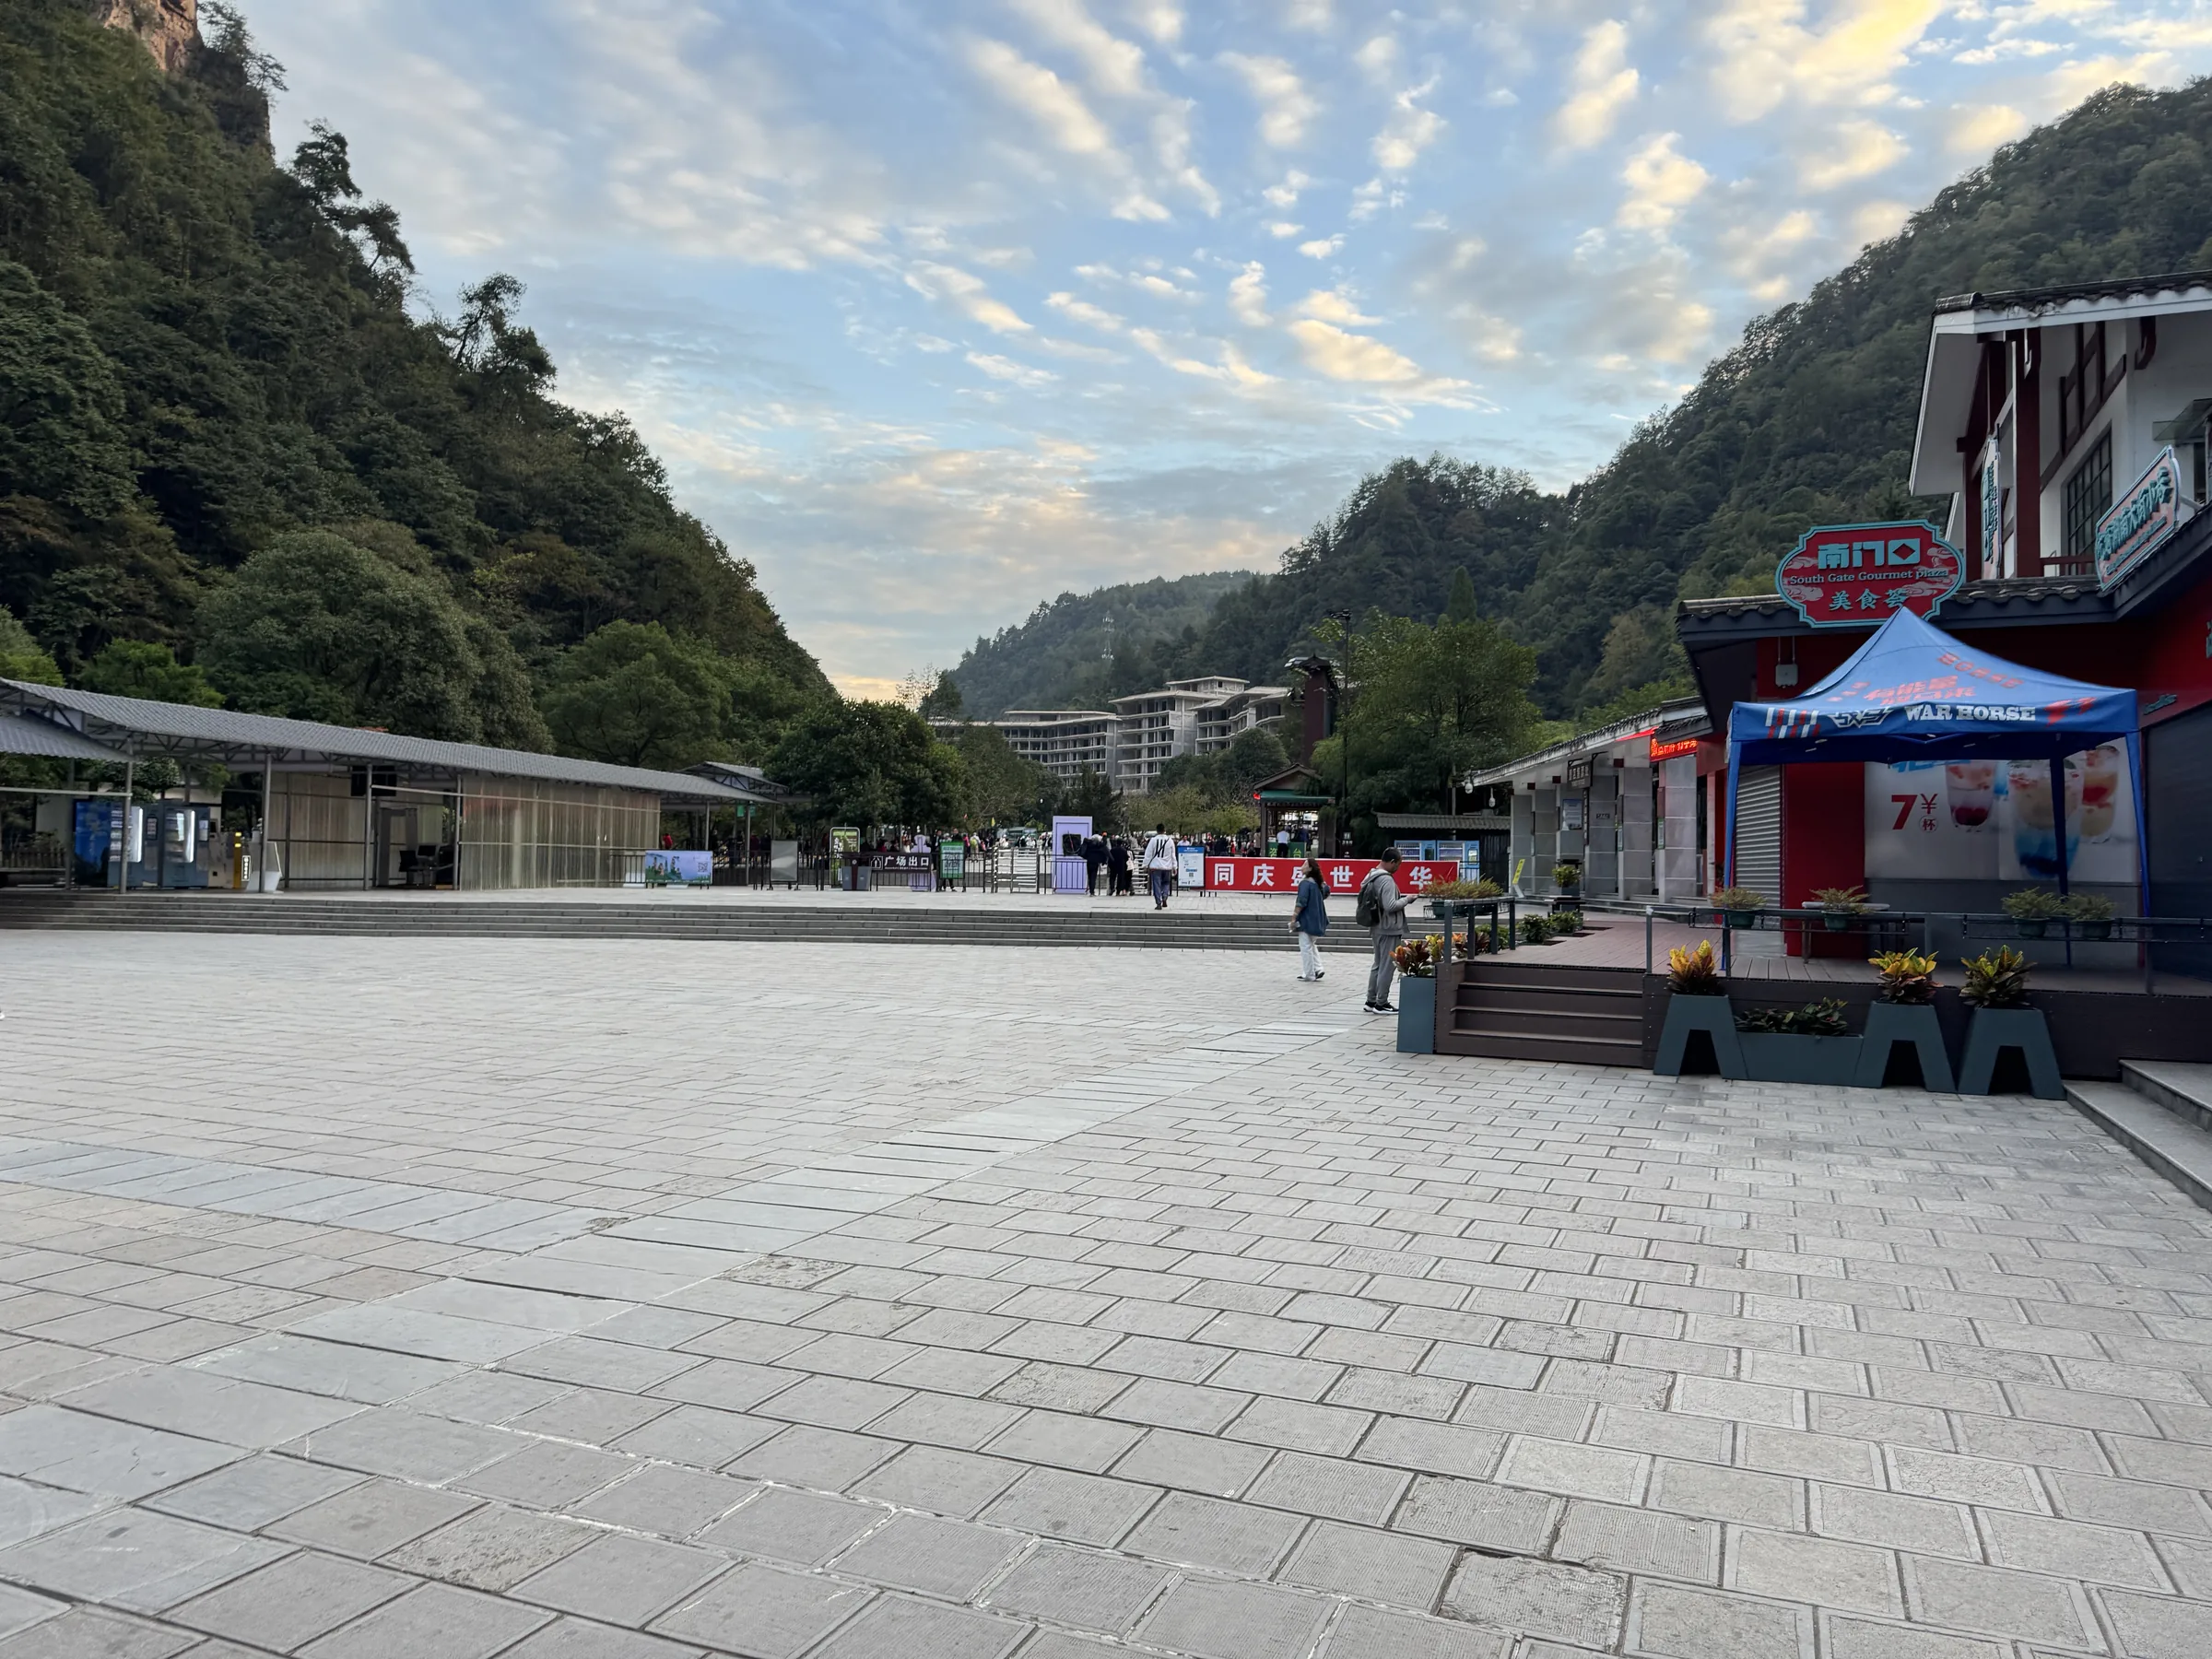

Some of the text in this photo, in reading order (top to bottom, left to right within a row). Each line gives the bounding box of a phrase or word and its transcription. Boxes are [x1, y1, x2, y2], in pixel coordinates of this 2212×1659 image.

[1790, 569, 1948, 584] South Gate Gourmet plaza
[1903, 705, 2036, 722] WAR HORSE
[1891, 794, 1918, 830] 7
[884, 855, 929, 866] 广场出口
